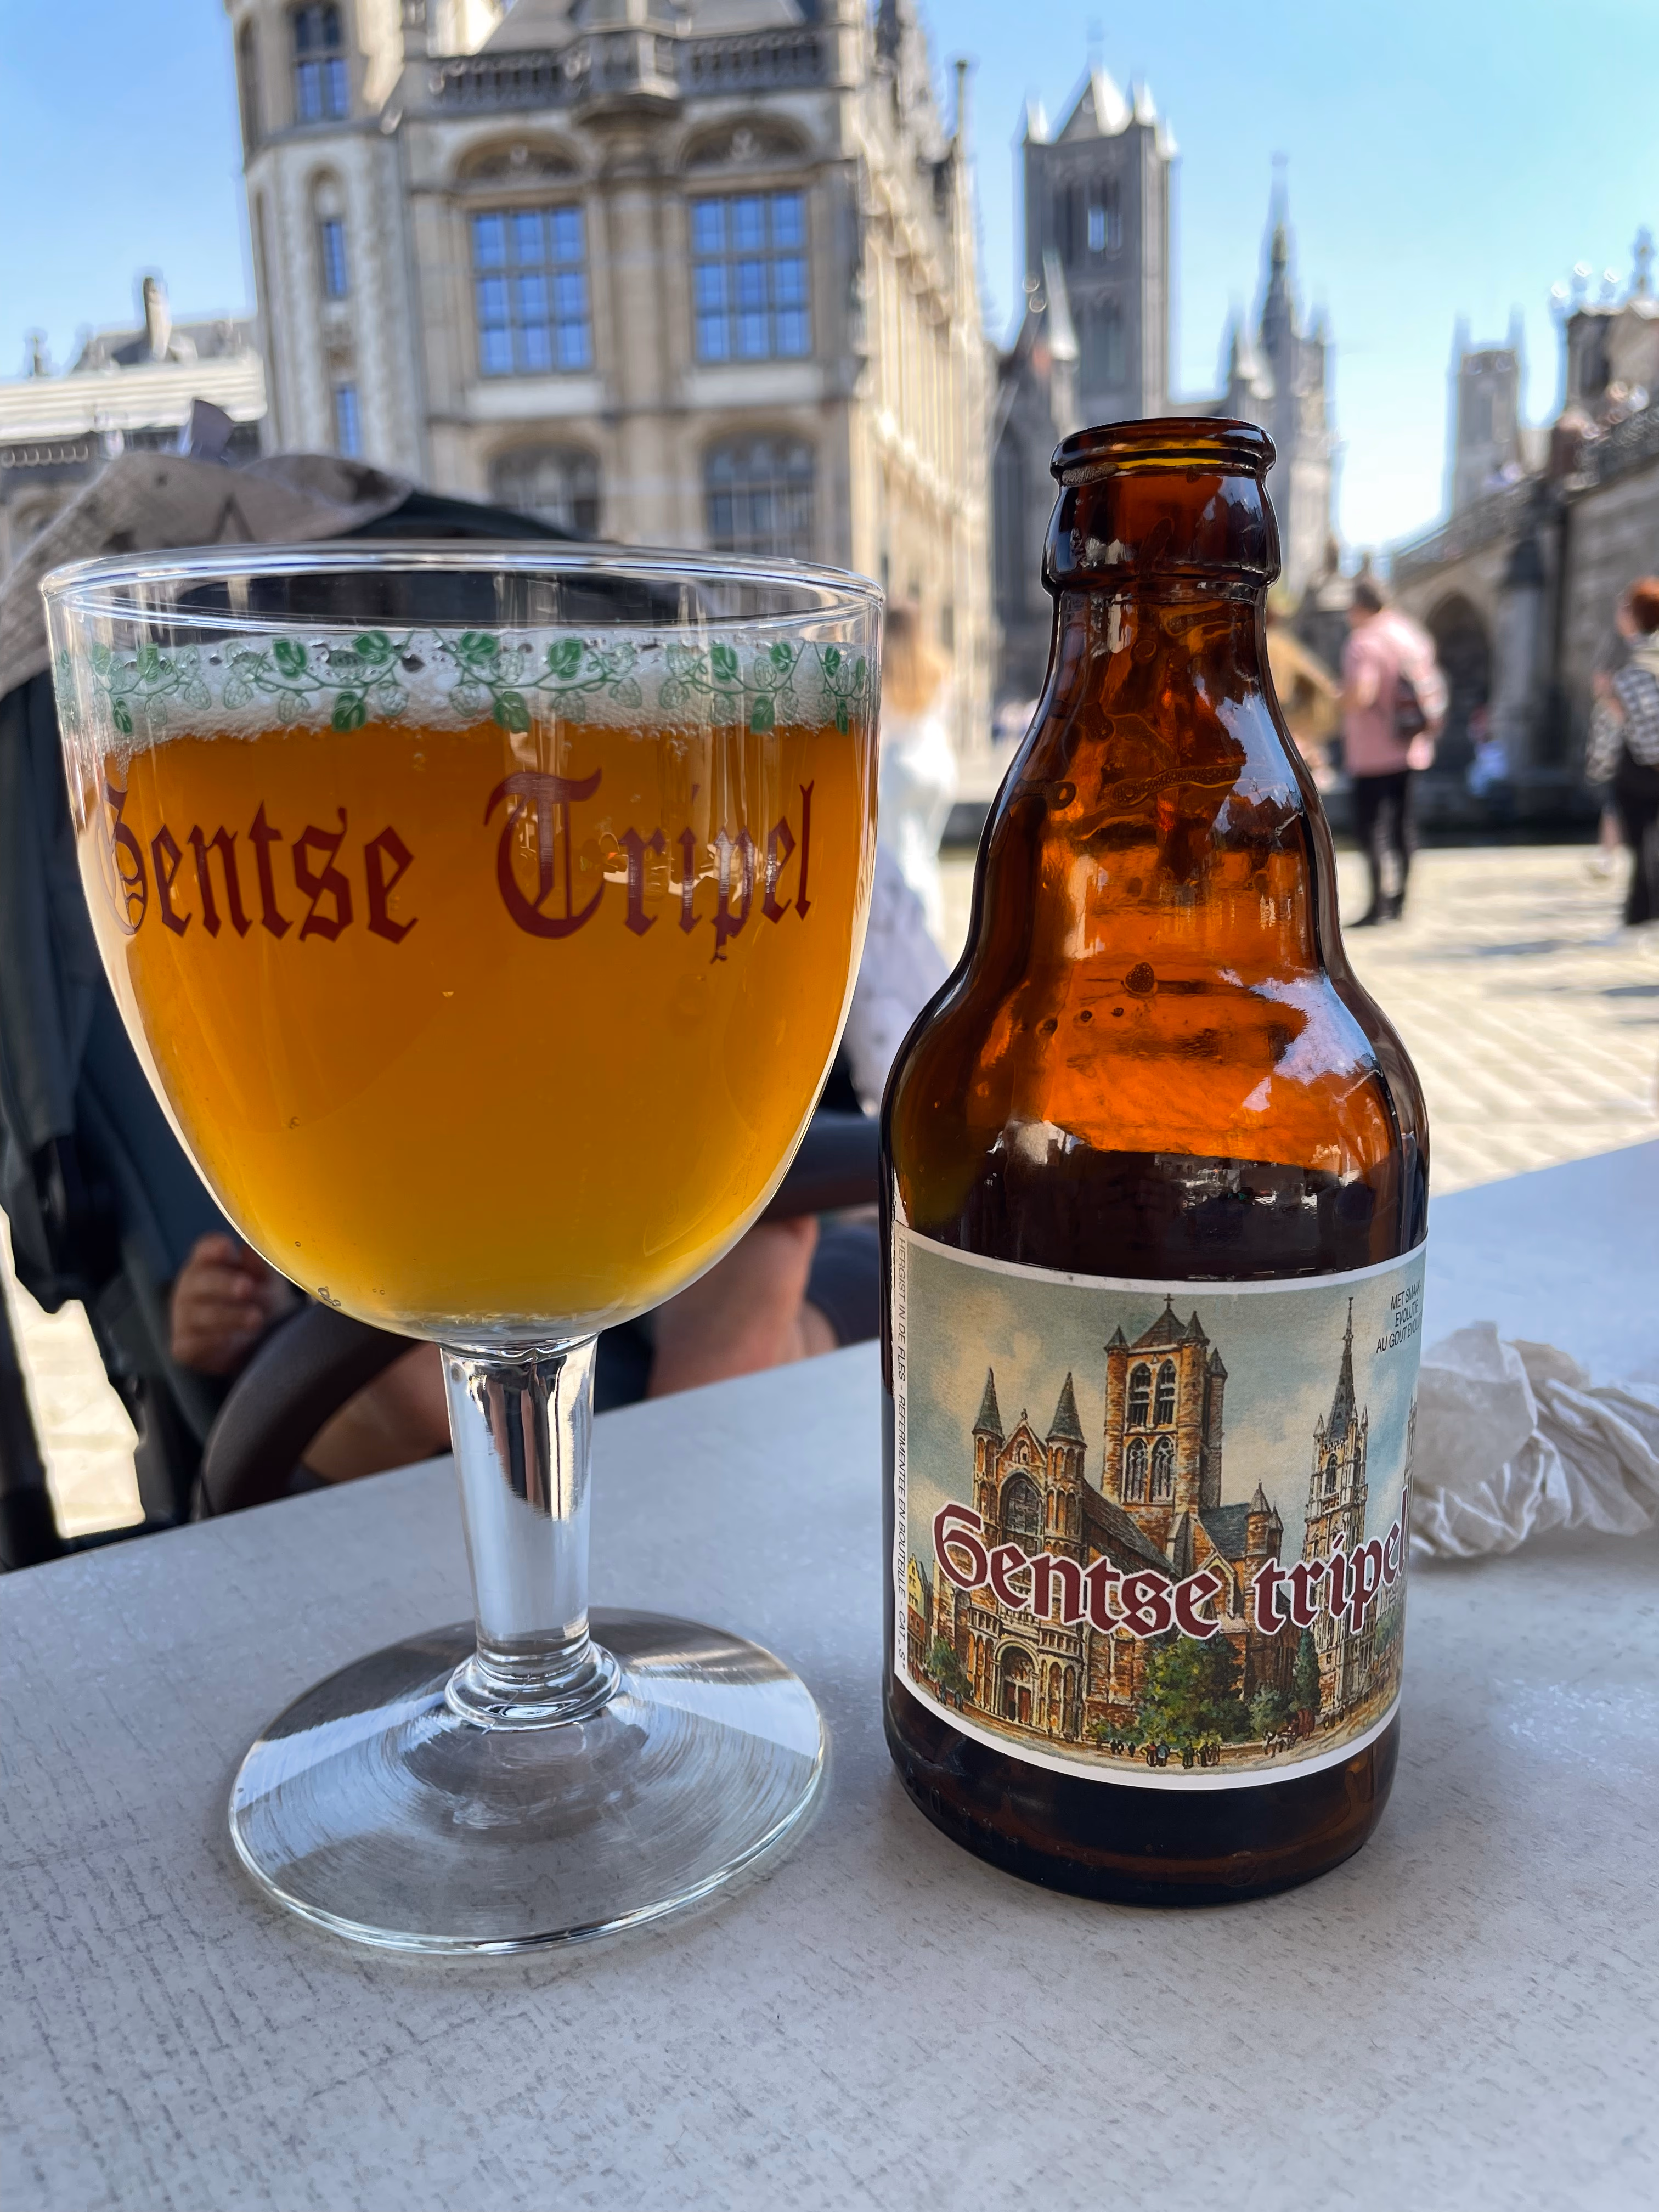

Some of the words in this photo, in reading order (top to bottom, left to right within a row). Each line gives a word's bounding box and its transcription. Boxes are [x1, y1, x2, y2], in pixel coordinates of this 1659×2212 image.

[483, 767, 815, 964] Tripel
[899, 1304, 906, 1320] IN
[1391, 1290, 1406, 1311] MET
[898, 1322, 906, 1345] DE
[1376, 1335, 1388, 1354] AU
[898, 1346, 906, 1381] FLES
[898, 1498, 906, 1520] EN
[898, 1521, 906, 1598] BOUTEILLE
[933, 1500, 1222, 1638] Gentse
[1252, 1485, 1408, 1635] tripel
